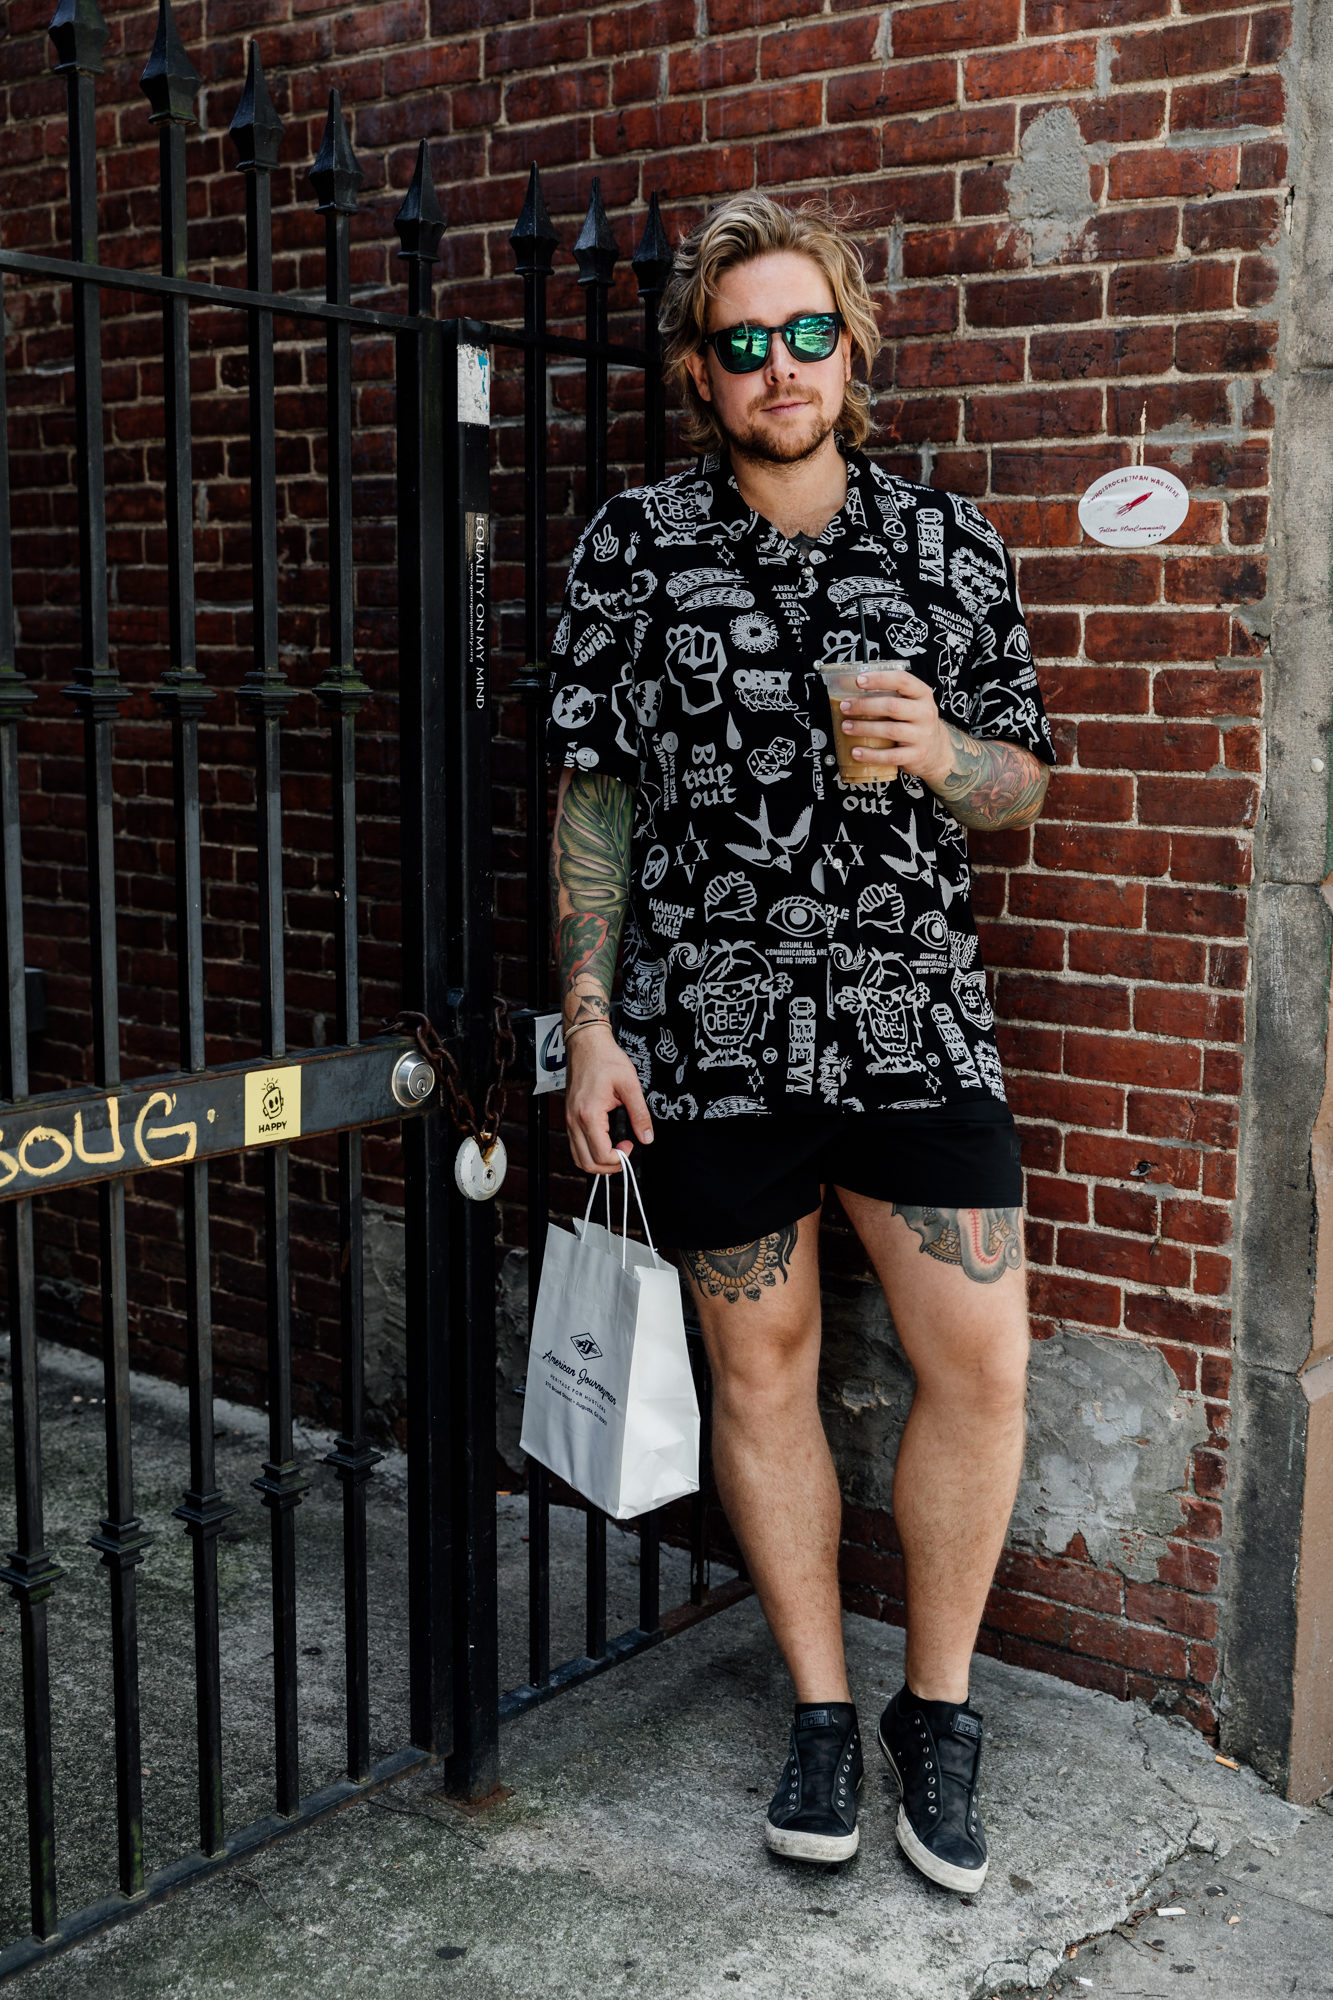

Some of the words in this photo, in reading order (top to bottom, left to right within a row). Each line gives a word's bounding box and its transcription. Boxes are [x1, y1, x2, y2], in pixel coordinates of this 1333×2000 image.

[1150, 478, 1164, 487] WAS
[1165, 485, 1180, 499] HERE
[1098, 526, 1117, 535] Follow
[475, 603, 485, 631] ON
[475, 636, 485, 662] MY
[573, 623, 598, 654] BETTER
[573, 623, 617, 666] LOVER!
[475, 667, 485, 709] MIND
[733, 669, 792, 690] OBEY
[567, 741, 578, 750] A
[652, 732, 660, 742] A
[653, 743, 669, 772] HAVE
[668, 754, 676, 775] DAY
[669, 776, 678, 804] NICE
[690, 785, 737, 809] out
[815, 773, 825, 800] NICE
[842, 795, 893, 816] out
[648, 897, 696, 919] HANDLE
[651, 921, 681, 939] CARE
[653, 911, 684, 928] WITH
[803, 941, 814, 949] ALL
[794, 957, 817, 965] TAPPED
[938, 954, 948, 962] ALL
[705, 1012, 750, 1031] OBEY
[873, 1018, 905, 1039] OBEY
[546, 1024, 567, 1063] 4
[259, 1121, 287, 1133] HAPPY
[542, 1350, 576, 1377] American
[576, 1368, 617, 1406] Journeyman
[572, 1388, 583, 1397] FOR
[585, 1394, 606, 1413] HUSTLERS
